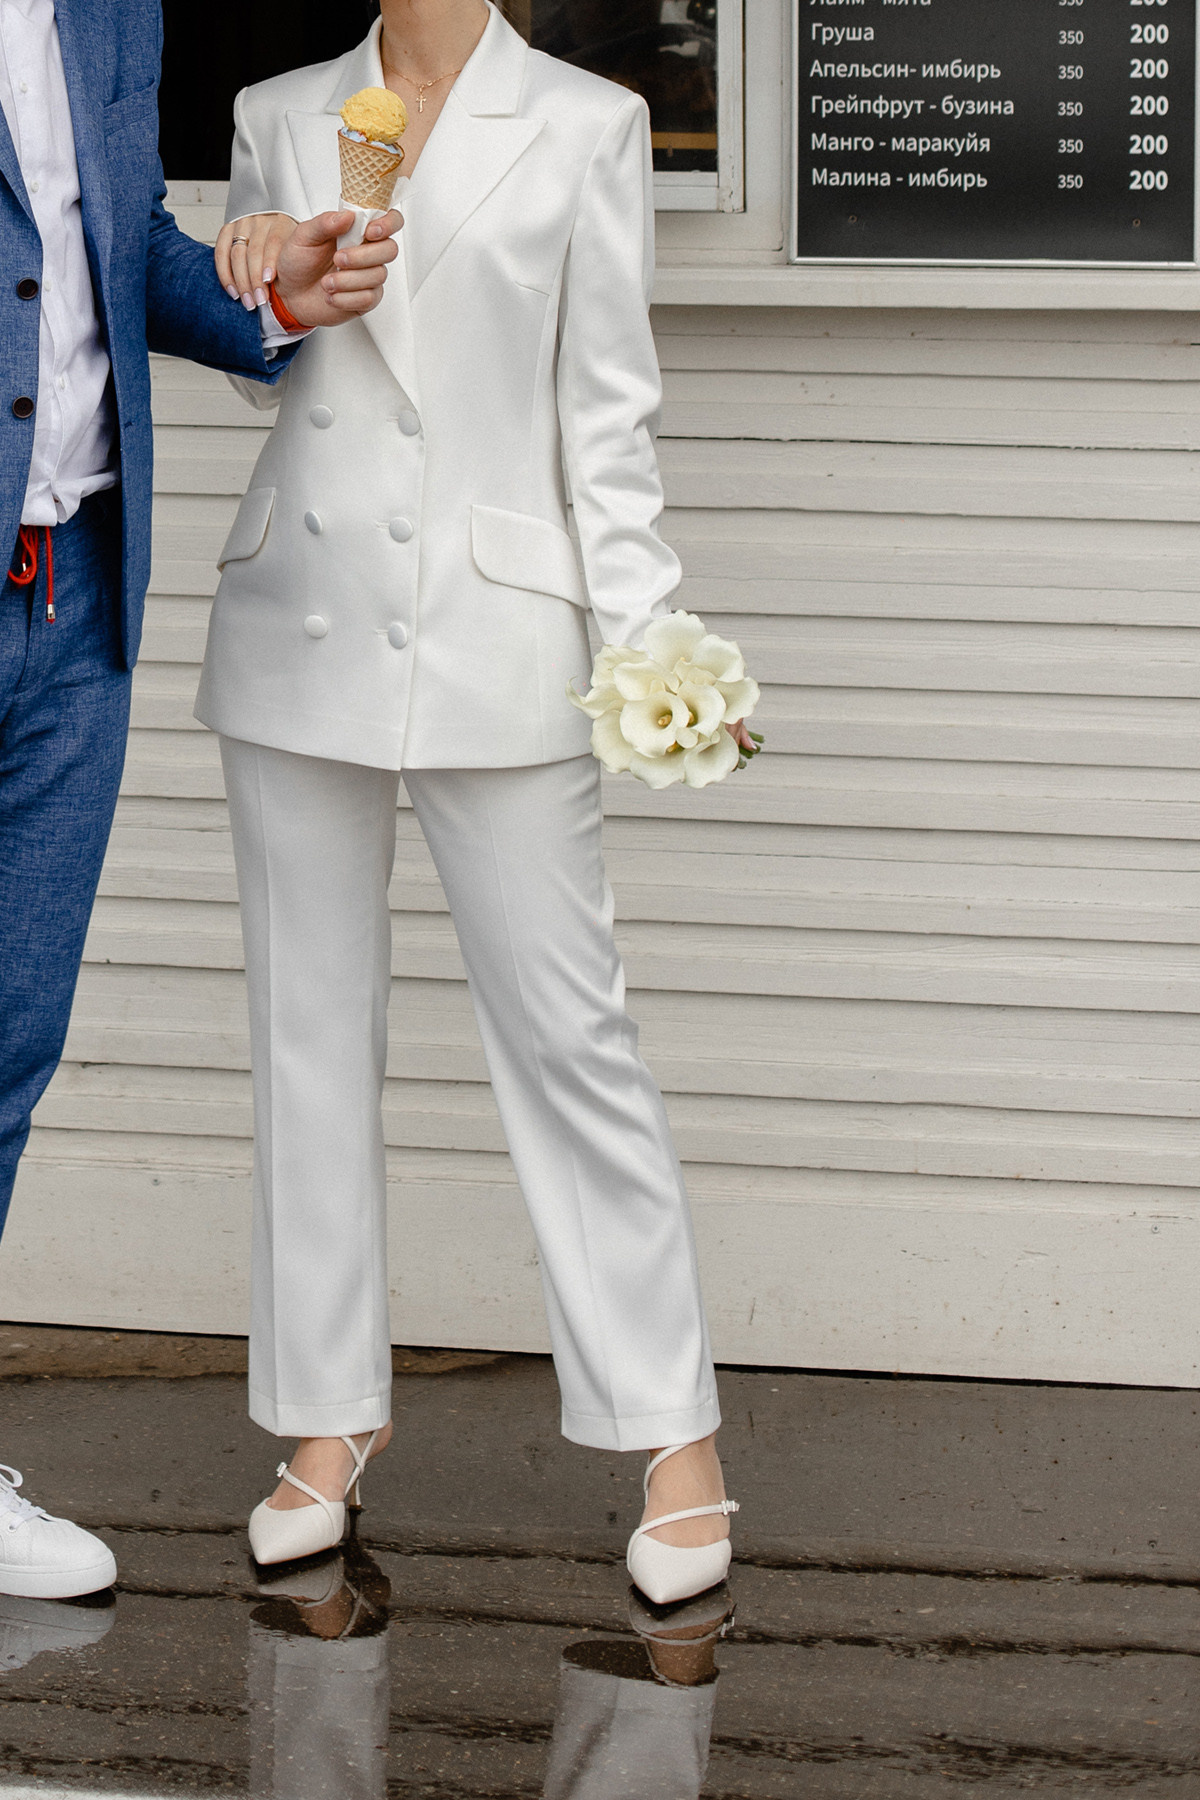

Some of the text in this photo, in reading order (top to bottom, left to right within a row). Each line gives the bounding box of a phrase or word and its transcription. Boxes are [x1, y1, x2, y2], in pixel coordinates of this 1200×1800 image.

[812, 23, 1169, 45] Груша 350 200
[922, 59, 1001, 82] имбирь
[1059, 65, 1083, 79] 350
[1130, 59, 1168, 78] 200
[812, 95, 924, 118] Грейпфрут
[942, 95, 1014, 119] бузина
[1058, 102, 1083, 116] 350
[1130, 96, 1168, 115] 200
[812, 133, 874, 151] Манго
[892, 133, 990, 156] маракуйя
[1058, 139, 1083, 153] 350
[1130, 135, 1168, 154] 200
[813, 168, 890, 186] Малина
[909, 168, 987, 191] имбирь
[1058, 175, 1083, 188] 350
[1130, 170, 1168, 190] 200
